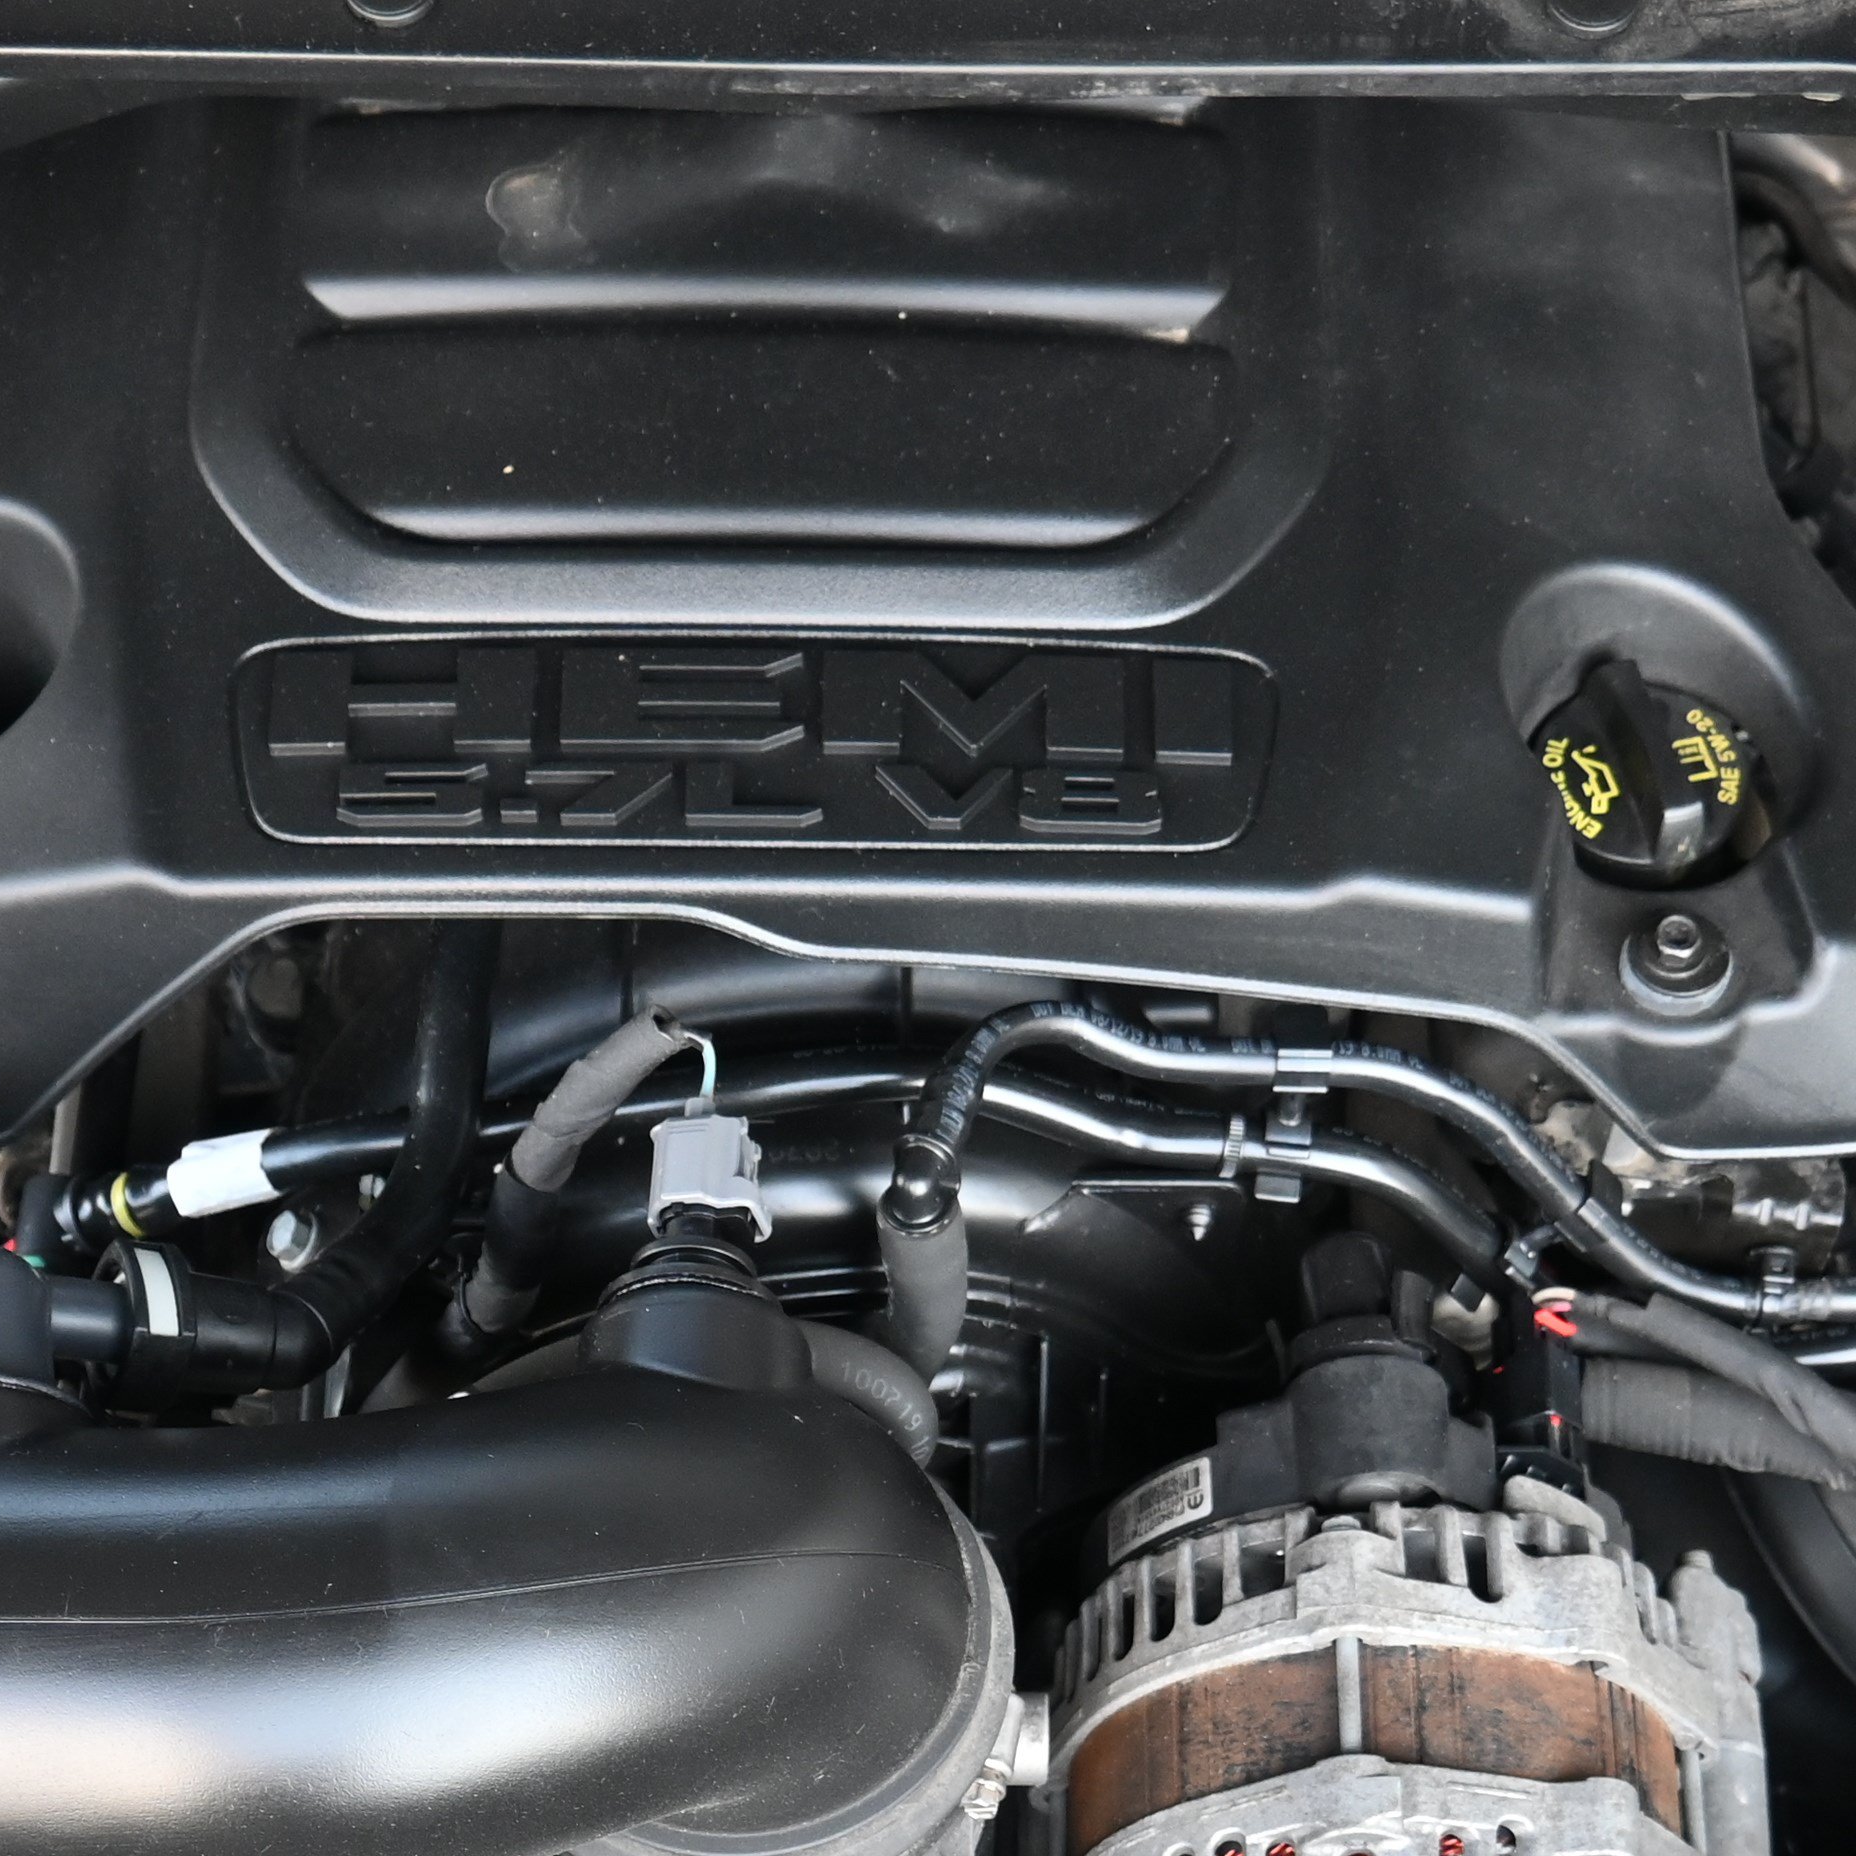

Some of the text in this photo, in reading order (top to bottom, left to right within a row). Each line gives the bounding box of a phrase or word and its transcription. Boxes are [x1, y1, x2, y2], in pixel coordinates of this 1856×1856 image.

[270, 647, 1232, 765] HEMI
[1542, 737, 1570, 769] OIL
[1686, 708, 1741, 806] SAE 5W-20
[336, 761, 1162, 835] 5.7L V8
